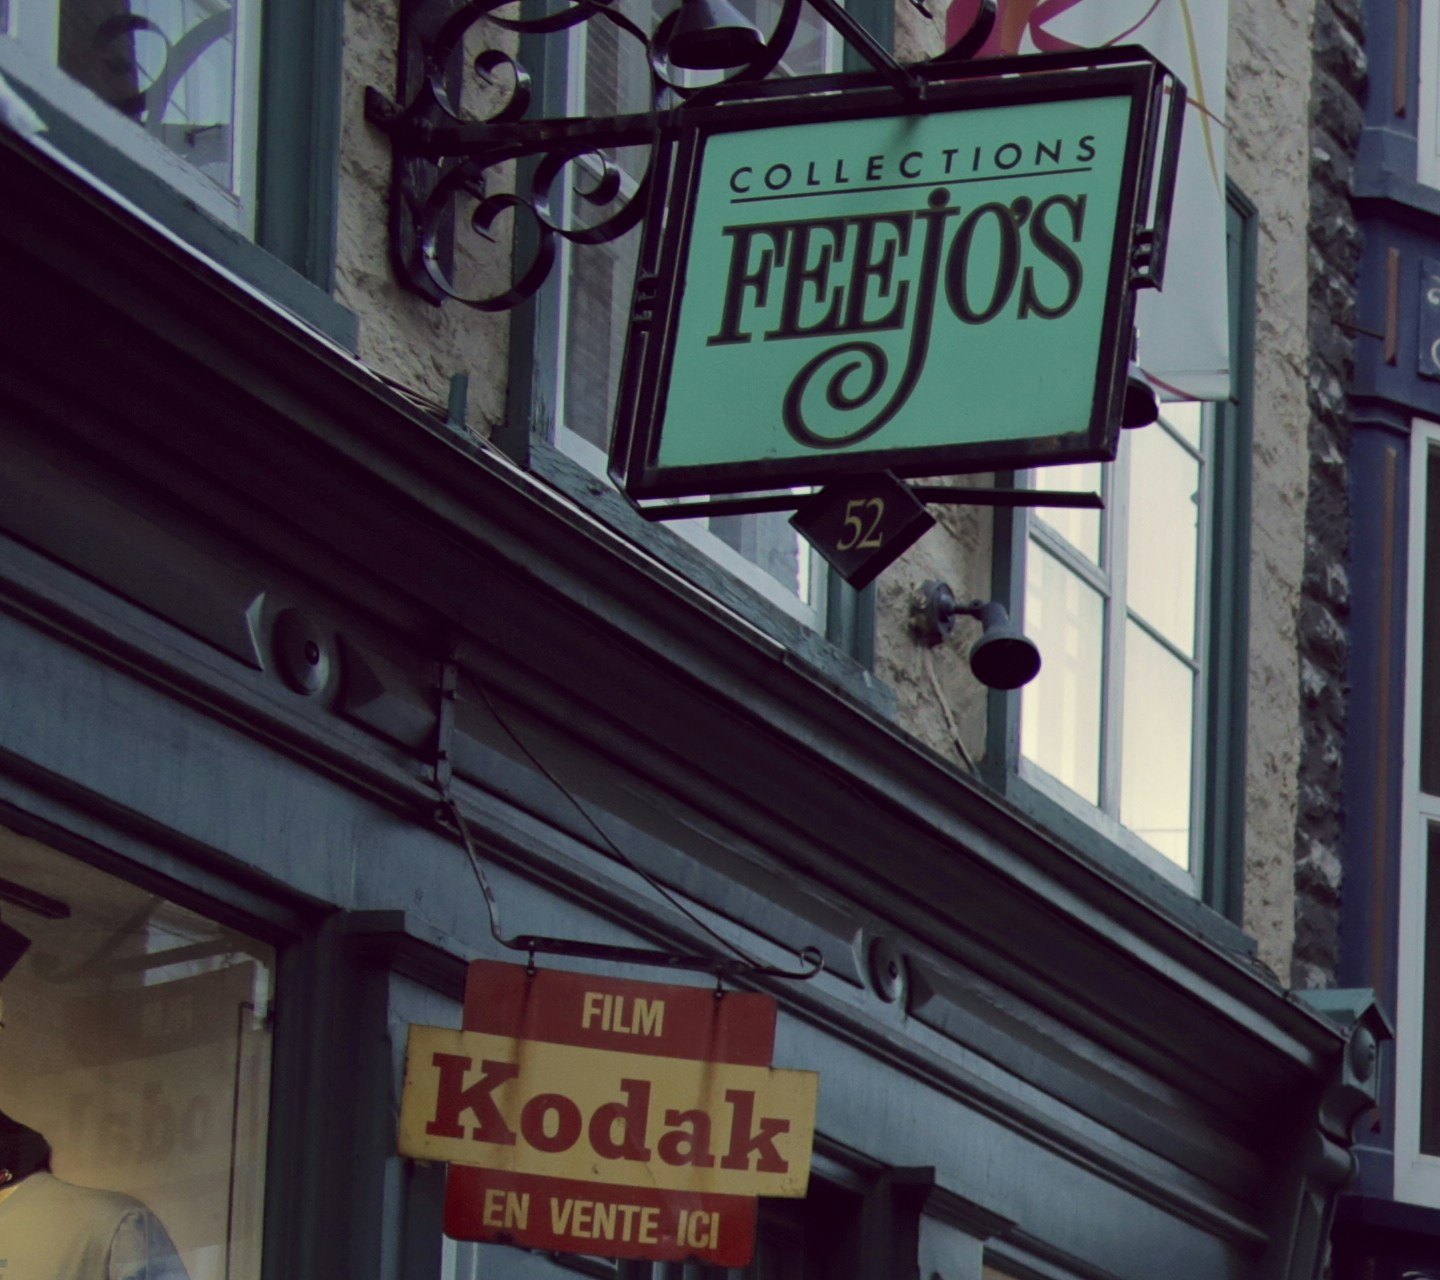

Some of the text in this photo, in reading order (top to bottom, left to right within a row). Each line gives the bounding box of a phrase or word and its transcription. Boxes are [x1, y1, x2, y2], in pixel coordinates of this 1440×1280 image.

[730, 135, 1098, 194] COLLECTIONS
[835, 495, 885, 552] 52
[581, 991, 666, 1038] FILM
[425, 1052, 791, 1174] Kodak
[482, 1188, 720, 1250] EN VENTE ICI
